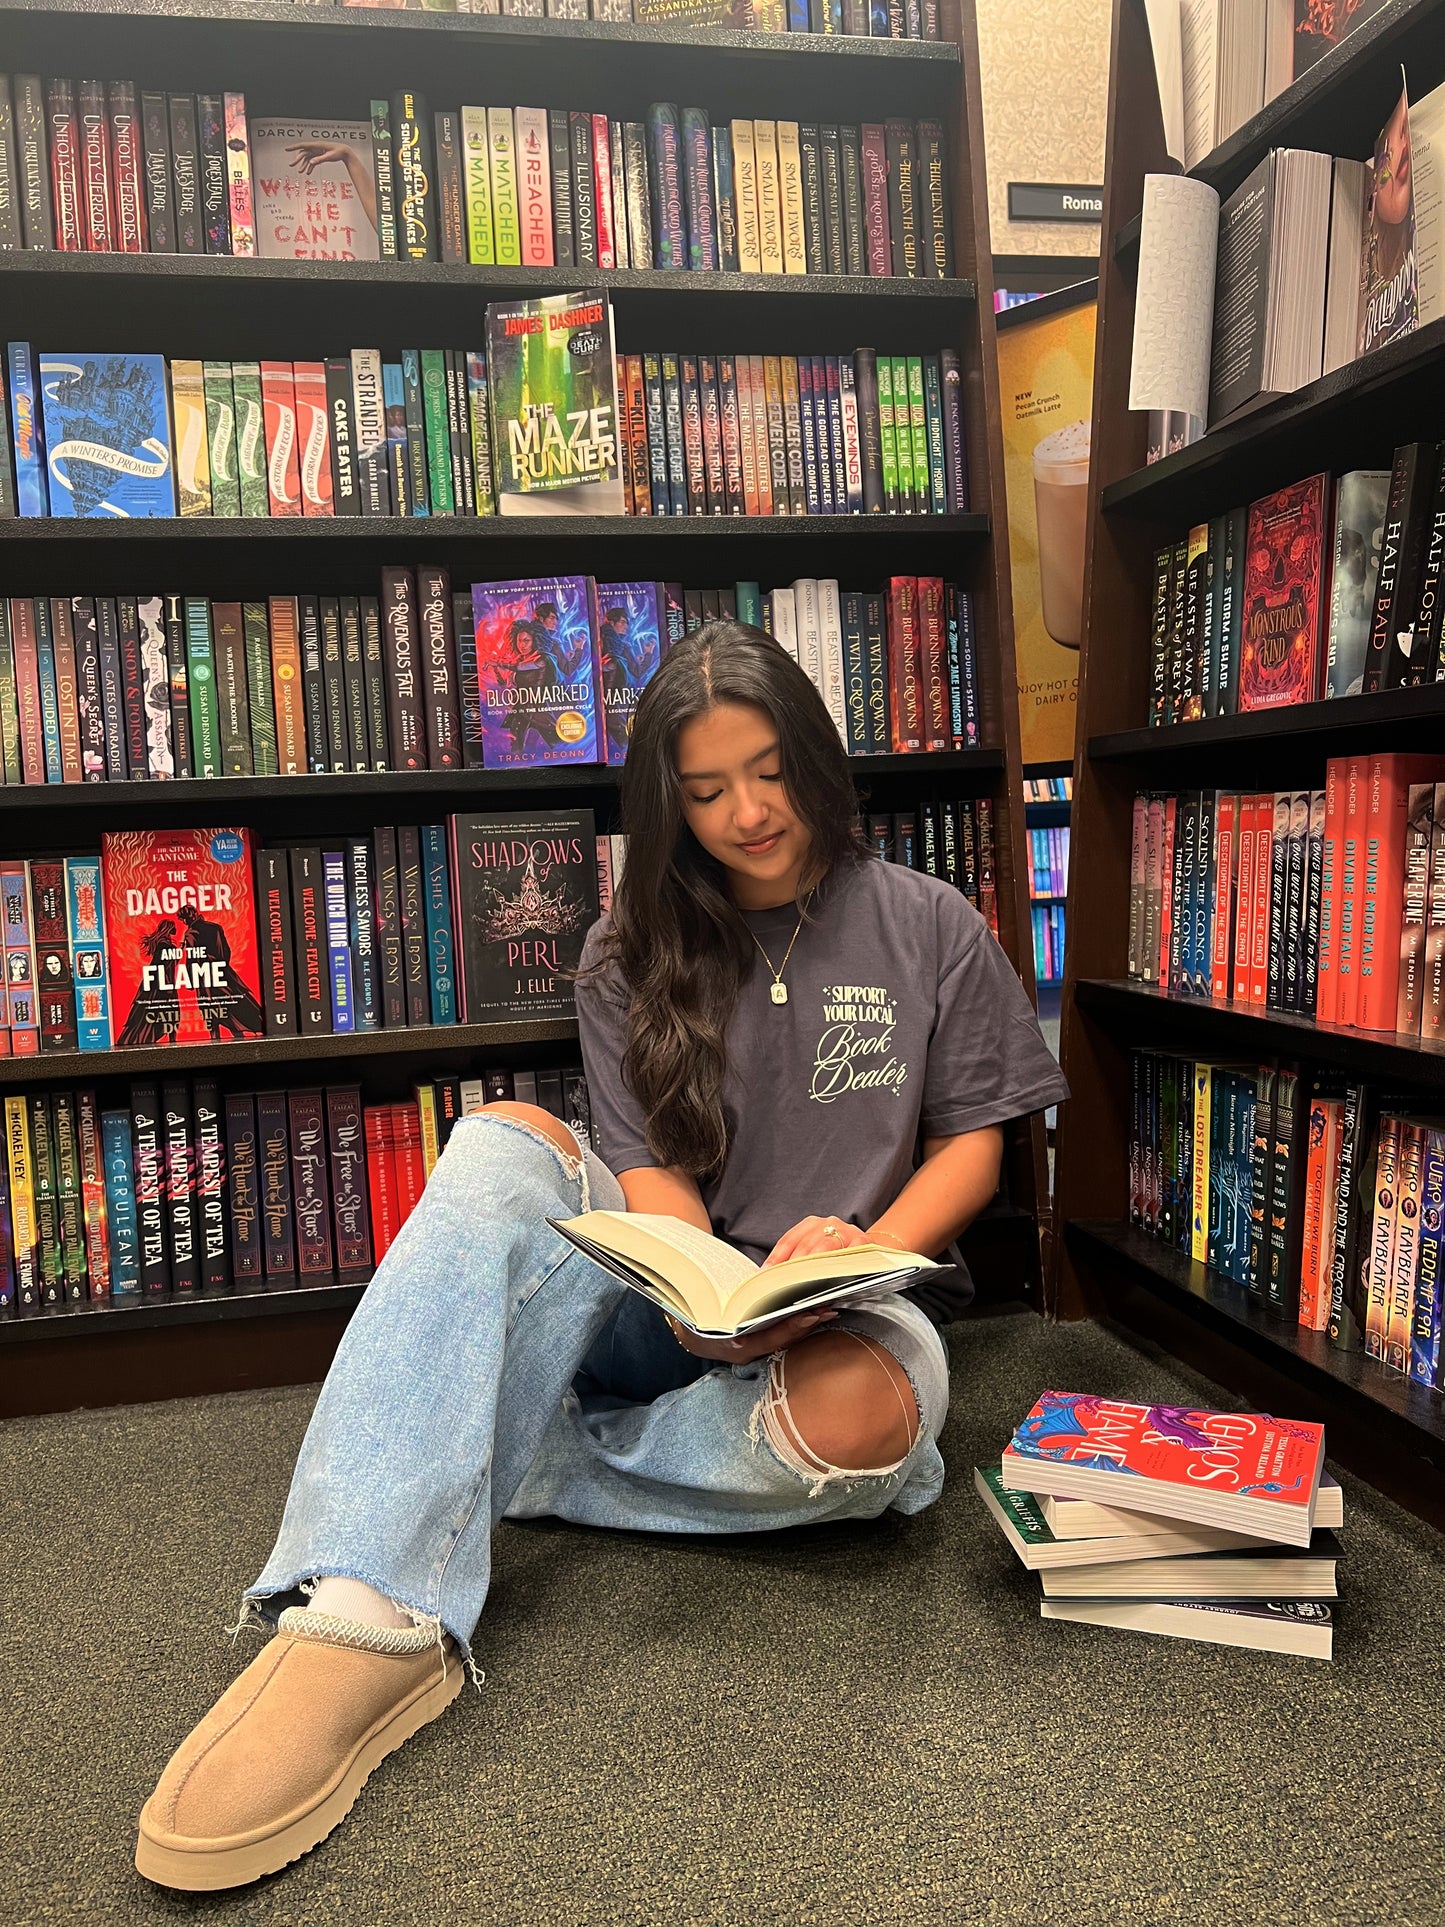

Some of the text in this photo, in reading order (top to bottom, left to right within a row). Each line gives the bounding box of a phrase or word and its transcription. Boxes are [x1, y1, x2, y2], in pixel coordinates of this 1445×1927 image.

[404, 94, 414, 119] COLLINS
[257, 129, 367, 140] DARCY COATES
[401, 123, 412, 182] SONGBIRDS
[413, 147, 421, 161] THE
[233, 170, 245, 211] BELLES
[259, 178, 354, 200] WHERE
[377, 149, 395, 255] SPINDLE AND DAGGER
[469, 157, 488, 258] MATCHED
[526, 158, 546, 261] REACHED
[305, 203, 340, 222] HE
[406, 202, 416, 244] SNAKES
[577, 162, 593, 262] ILLUSIONARY
[273, 225, 357, 246] CAN'T
[504, 305, 604, 336] JAMES DASHNER
[358, 356, 380, 446] THE STRANDED
[523, 402, 554, 418] THE
[1015, 391, 1032, 401] NEW
[1016, 394, 1060, 411] Pecan Crunch
[1016, 404, 1061, 420] Oatmilk Latte
[334, 399, 353, 498] CAKE EATER
[508, 406, 615, 455] MAZE
[62, 444, 158, 475] A WINTER'S PROMISE
[512, 443, 616, 480] RUNNER
[817, 399, 832, 505] THE GODHEAD COMPLEX
[545, 478, 561, 487] MAJOR
[562, 476, 580, 485] MOTION
[1372, 521, 1402, 651] HALF BAD
[1418, 511, 1445, 639] HALF LOST
[388, 578, 413, 698] THIS RAVENOUS FATE
[1154, 574, 1168, 694] BEASTS of PREY
[1249, 602, 1304, 640] MONSTROUS
[825, 585, 843, 729] DONNELLY BEASTLY BEAUTY
[1260, 636, 1287, 667] KIND
[82, 655, 97, 702] QUEEN'S
[487, 683, 589, 708] BLOODMARKED
[848, 633, 866, 742] TWIN CROWNS
[1047, 680, 1068, 690] HOT
[1250, 690, 1293, 705] LYDIA GREGOVIC
[59, 656, 78, 770] 6 LOST IN TIME
[104, 655, 121, 774] 7 GATES OF PARADISE
[124, 639, 144, 760] SNOW & POISON
[1036, 694, 1065, 705] DAIRY
[89, 705, 100, 747] SECRET
[199, 686, 212, 760] SUSAN DENNARD
[401, 710, 410, 751] DENNINGS
[409, 715, 417, 746] HAYLEY
[498, 749, 585, 763] TRACY DEONN
[471, 838, 584, 869] SHADOWS
[944, 815, 956, 882] MICHAEL VEY 1
[166, 870, 188, 883] THE
[539, 862, 555, 882] of
[1174, 847, 1182, 901] THREADS
[1362, 762, 1381, 977] HELANDER DIVINE MORTALS
[1405, 848, 1427, 925] CHAPERONE
[126, 884, 232, 917] DAGGER
[325, 861, 348, 948] THE WITCH KING
[353, 845, 371, 956] MERCILESS SAVIORS
[161, 946, 207, 961] AND THE
[302, 887, 321, 1001] WELCOME FEAR CITY
[508, 940, 563, 972] PERL
[142, 961, 228, 992] FLAME
[514, 978, 555, 994] J. ELLE
[832, 986, 887, 1005] SUPPORT
[823, 1005, 896, 1025] YOUR LOCAL
[814, 1022, 895, 1065] Book
[810, 1056, 908, 1104] Dealer
[1197, 1114, 1206, 1148] LOST
[1342, 1142, 1353, 1168] THE
[167, 1111, 193, 1264] A TEMPEST OF TEA
[1195, 1149, 1205, 1211] DREAMER
[1340, 1168, 1352, 1198] MAID
[112, 1136, 136, 1266] THE CERULEAN
[1338, 1199, 1348, 1226] AND
[1331, 1253, 1345, 1321] CROCODILE
[1071, 1401, 1152, 1468] FLAME
[1141, 1429, 1176, 1446] &
[1187, 1414, 1257, 1486] CHAOS
[1009, 1496, 1041, 1530] GRIFFIS
